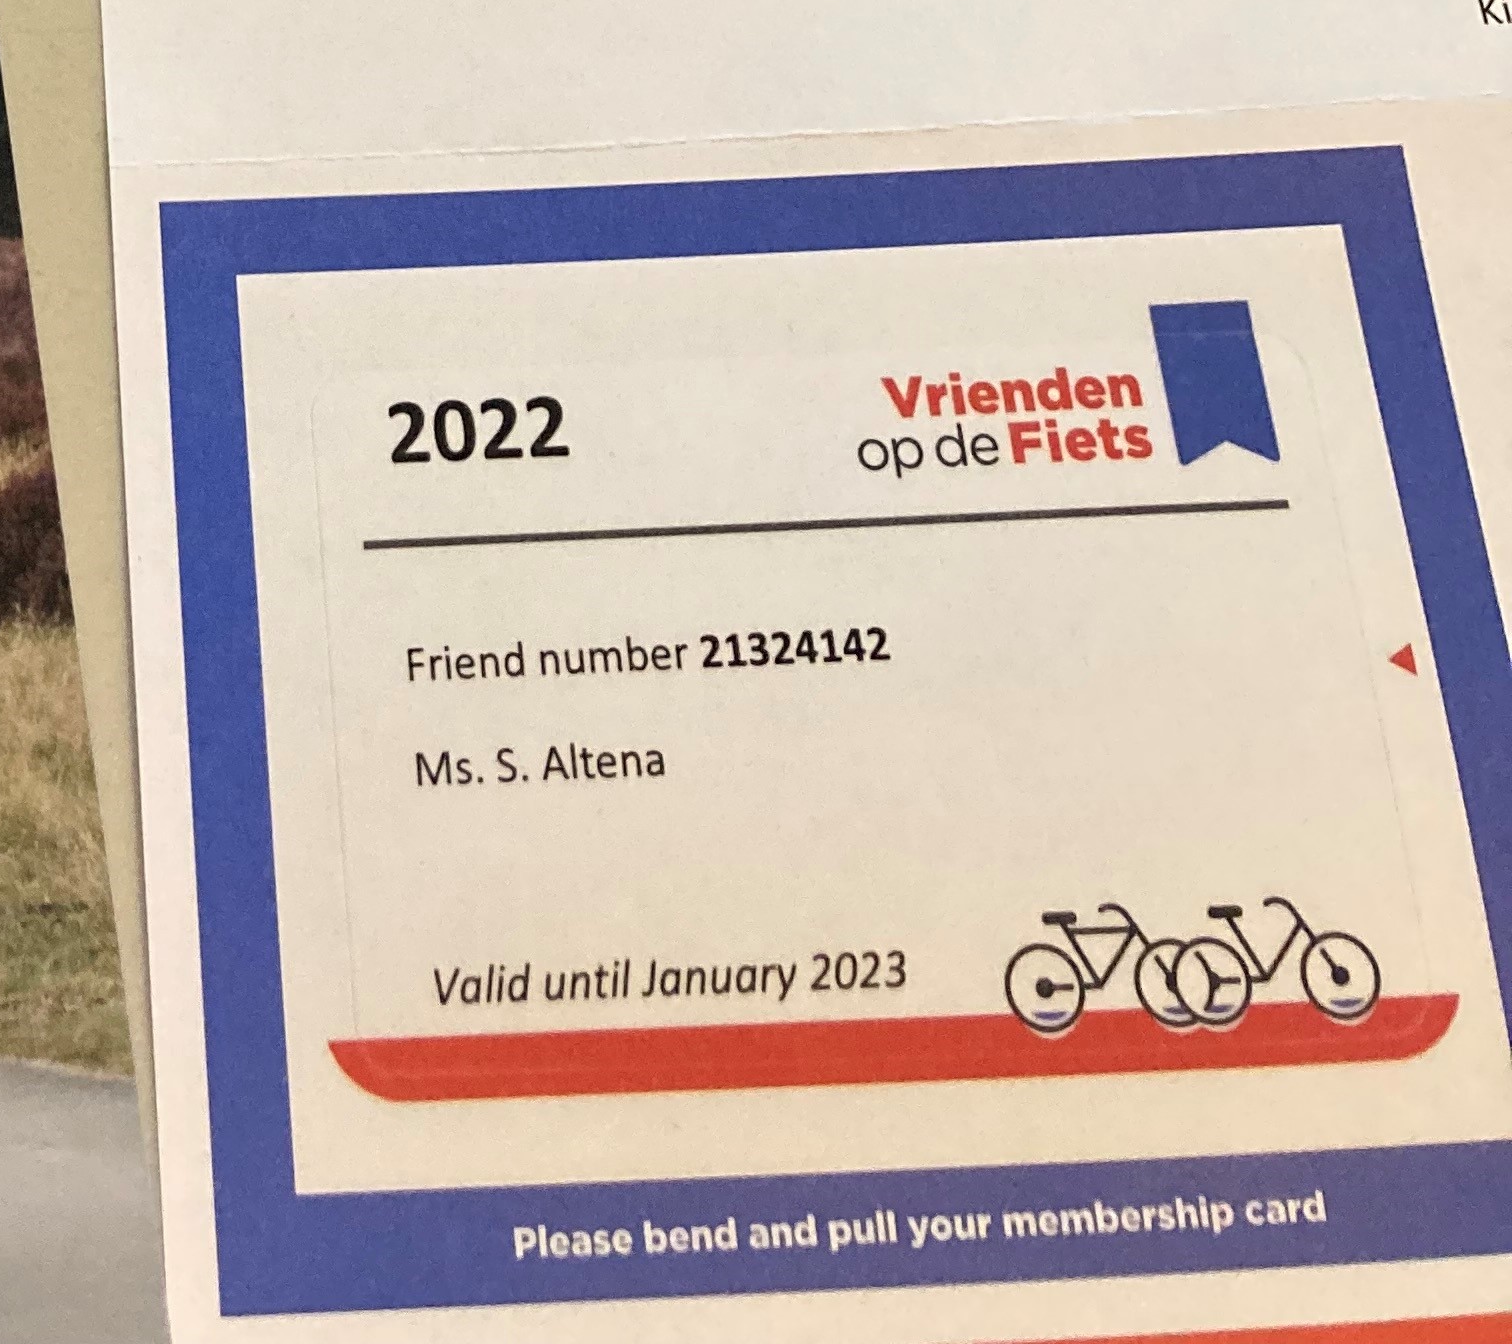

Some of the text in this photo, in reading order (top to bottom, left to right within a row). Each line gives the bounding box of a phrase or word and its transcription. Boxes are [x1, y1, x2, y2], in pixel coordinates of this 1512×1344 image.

[883, 368, 1143, 418] Vrienden
[389, 396, 569, 463] 2022
[858, 419, 1152, 478] op de Fiets
[408, 627, 890, 681] Friend number 21324142
[416, 743, 665, 786] Ms. S. Altena
[434, 950, 906, 1005] Valid until January 2023
[514, 1190, 1326, 1261] Please bend and pull your membership card
